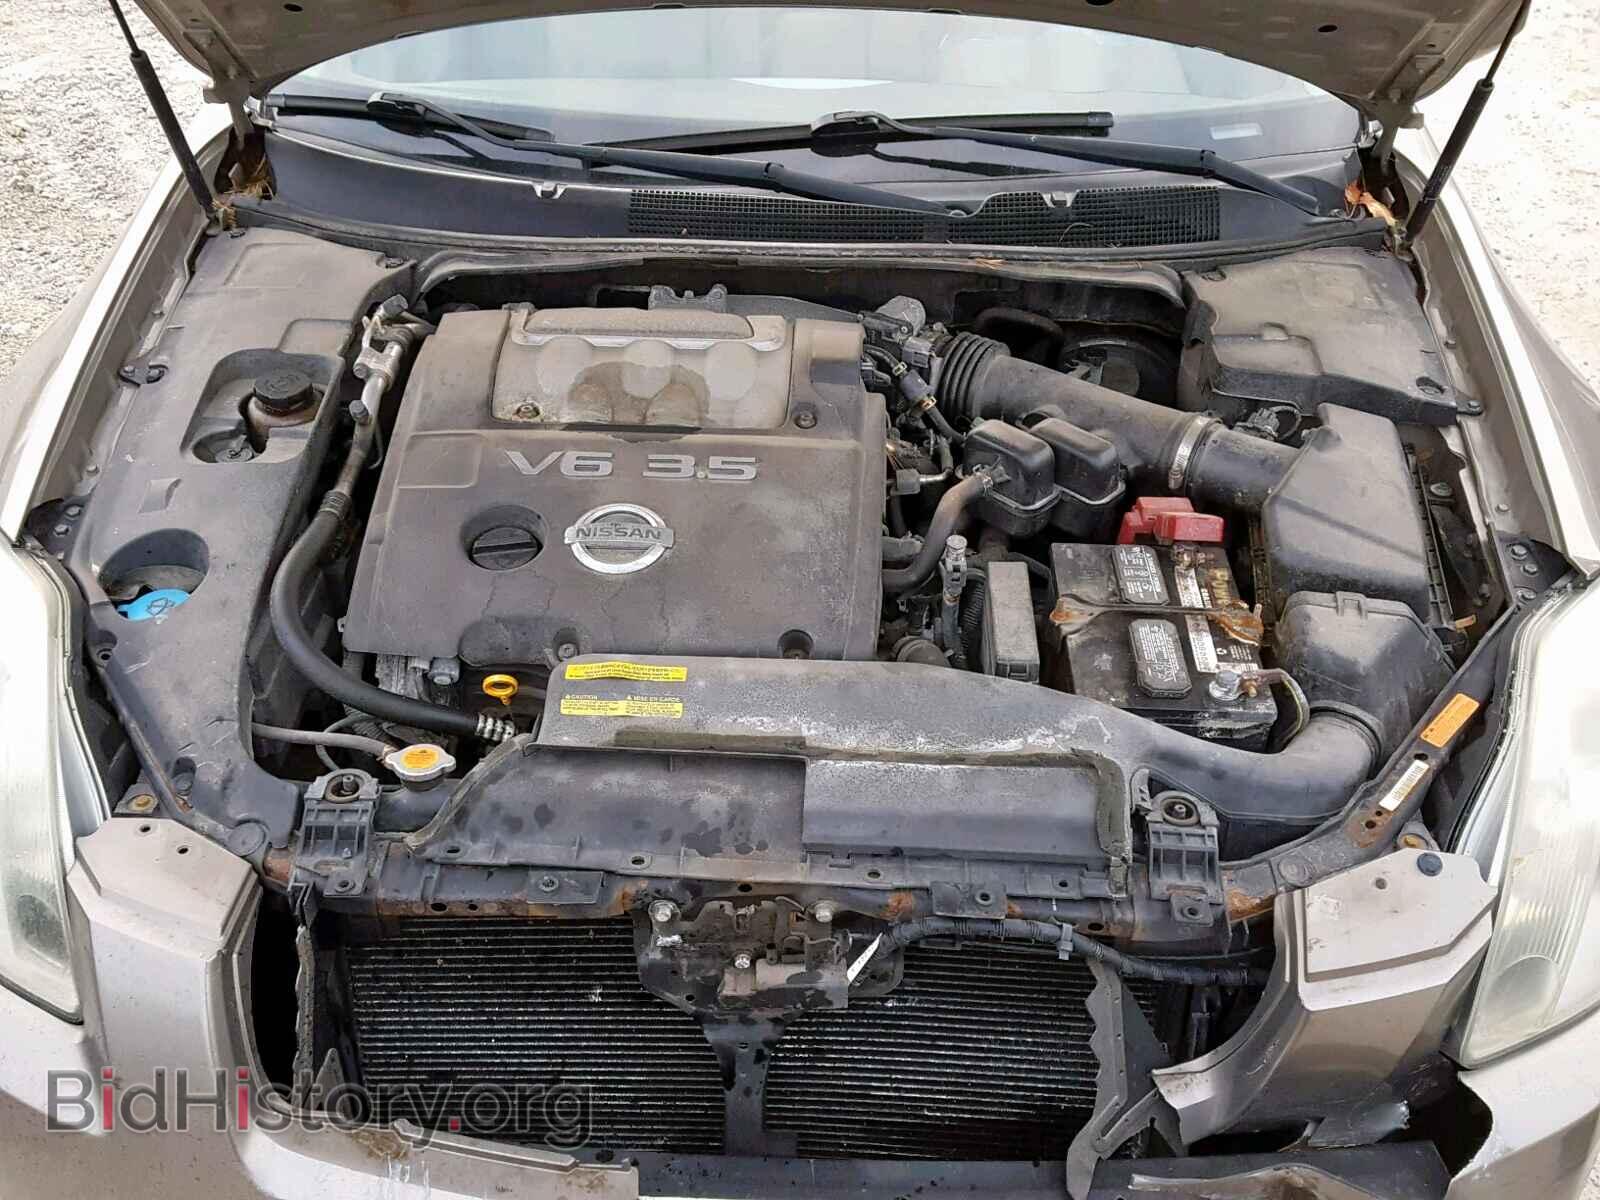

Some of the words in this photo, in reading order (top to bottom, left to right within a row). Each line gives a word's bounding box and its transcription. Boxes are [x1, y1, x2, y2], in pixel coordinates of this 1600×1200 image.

[505, 450, 614, 478] V6
[642, 453, 758, 481] 3.5
[575, 526, 662, 540] NISSAN
